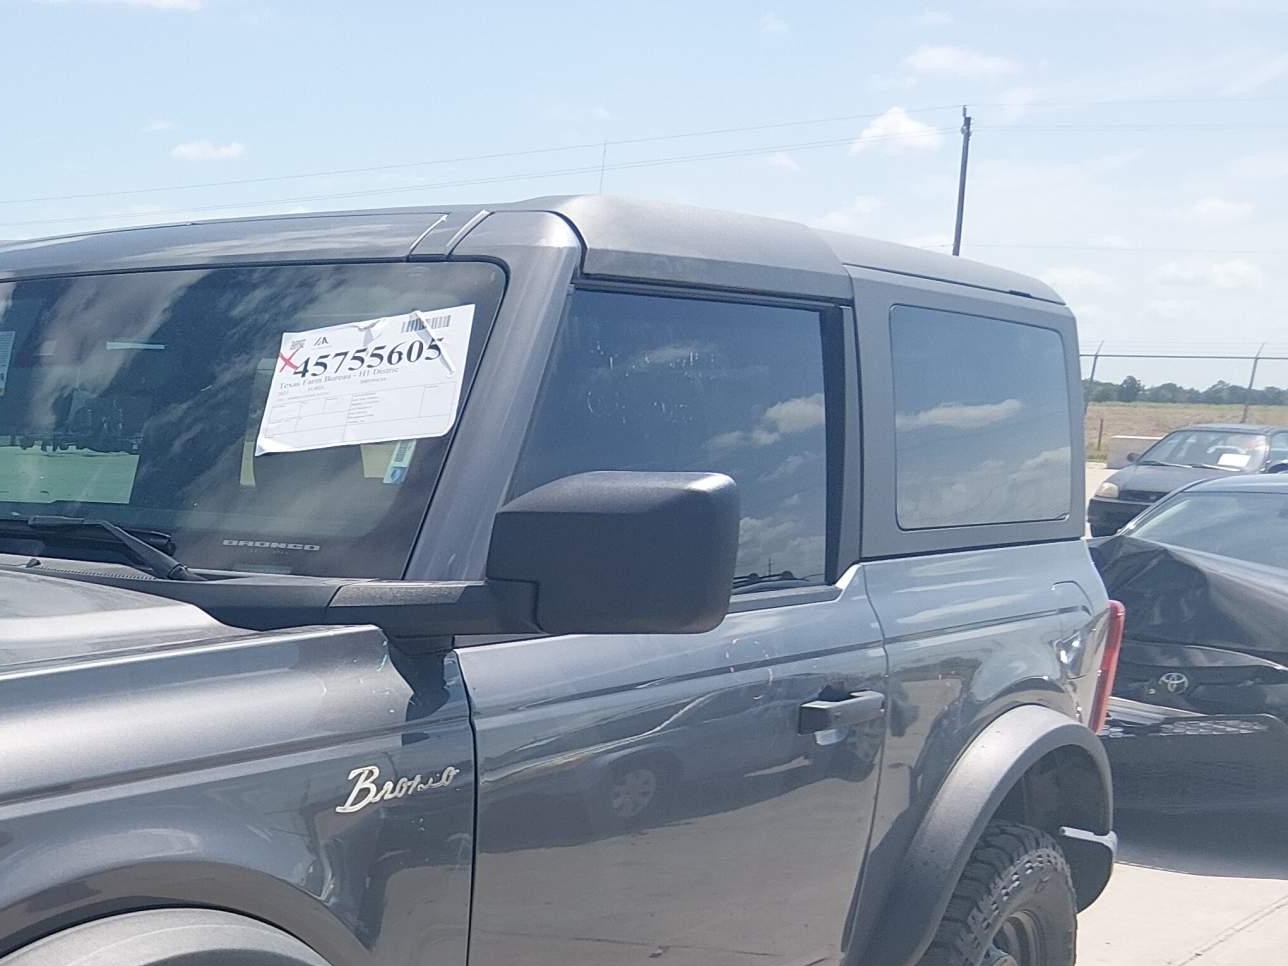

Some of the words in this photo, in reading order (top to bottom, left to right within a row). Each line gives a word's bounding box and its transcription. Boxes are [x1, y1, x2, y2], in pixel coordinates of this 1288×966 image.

[293, 337, 444, 378] 45755605
[280, 381, 300, 390] Texas
[302, 378, 322, 386] Farm
[324, 374, 352, 383] Bureau
[223, 540, 321, 551] BRONCO
